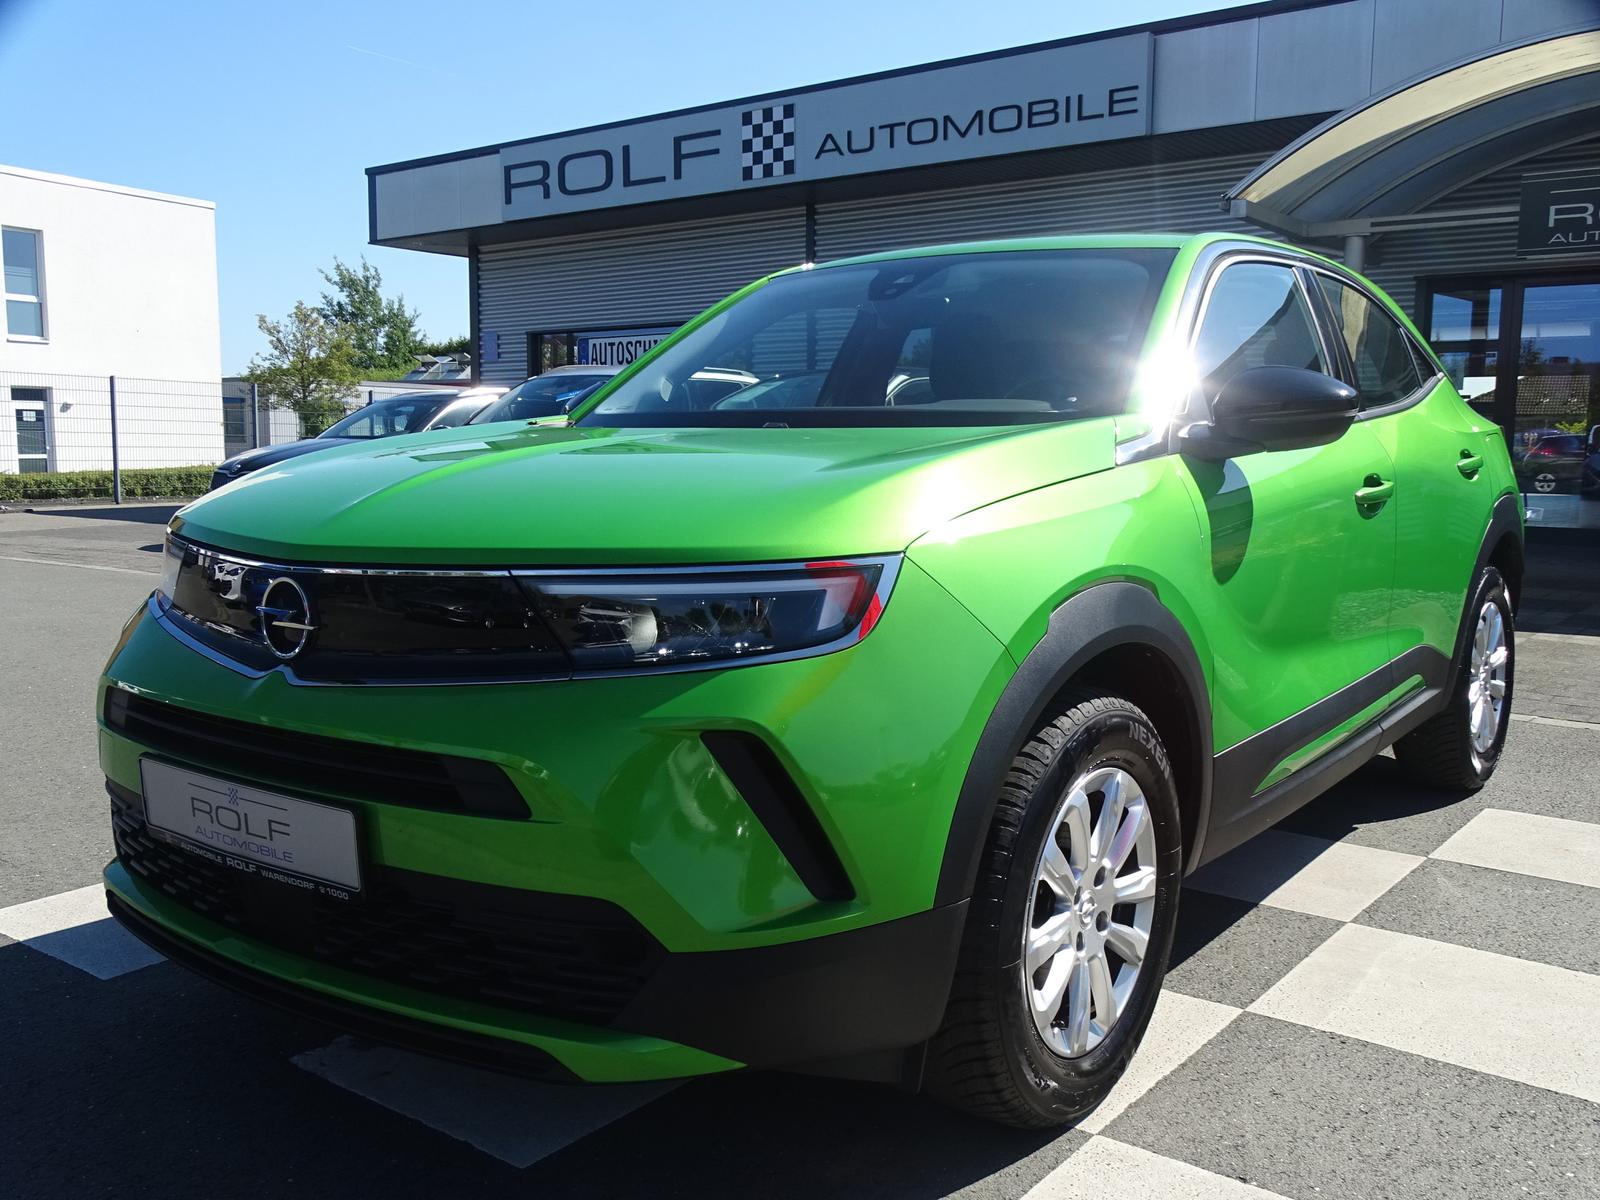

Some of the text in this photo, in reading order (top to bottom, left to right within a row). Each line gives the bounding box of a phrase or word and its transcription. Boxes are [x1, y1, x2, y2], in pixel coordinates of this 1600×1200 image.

[503, 84, 1140, 206] ROLF AUTOMOBILE
[1548, 203, 1600, 227] R
[1128, 720, 1170, 780] NEXEN
[190, 796, 291, 842] ROLF
[181, 842, 223, 863] AUTOMOBILE
[226, 857, 257, 873] ROLF
[260, 869, 315, 889] WARENDORF
[195, 825, 295, 863] AUTOMOBILE
